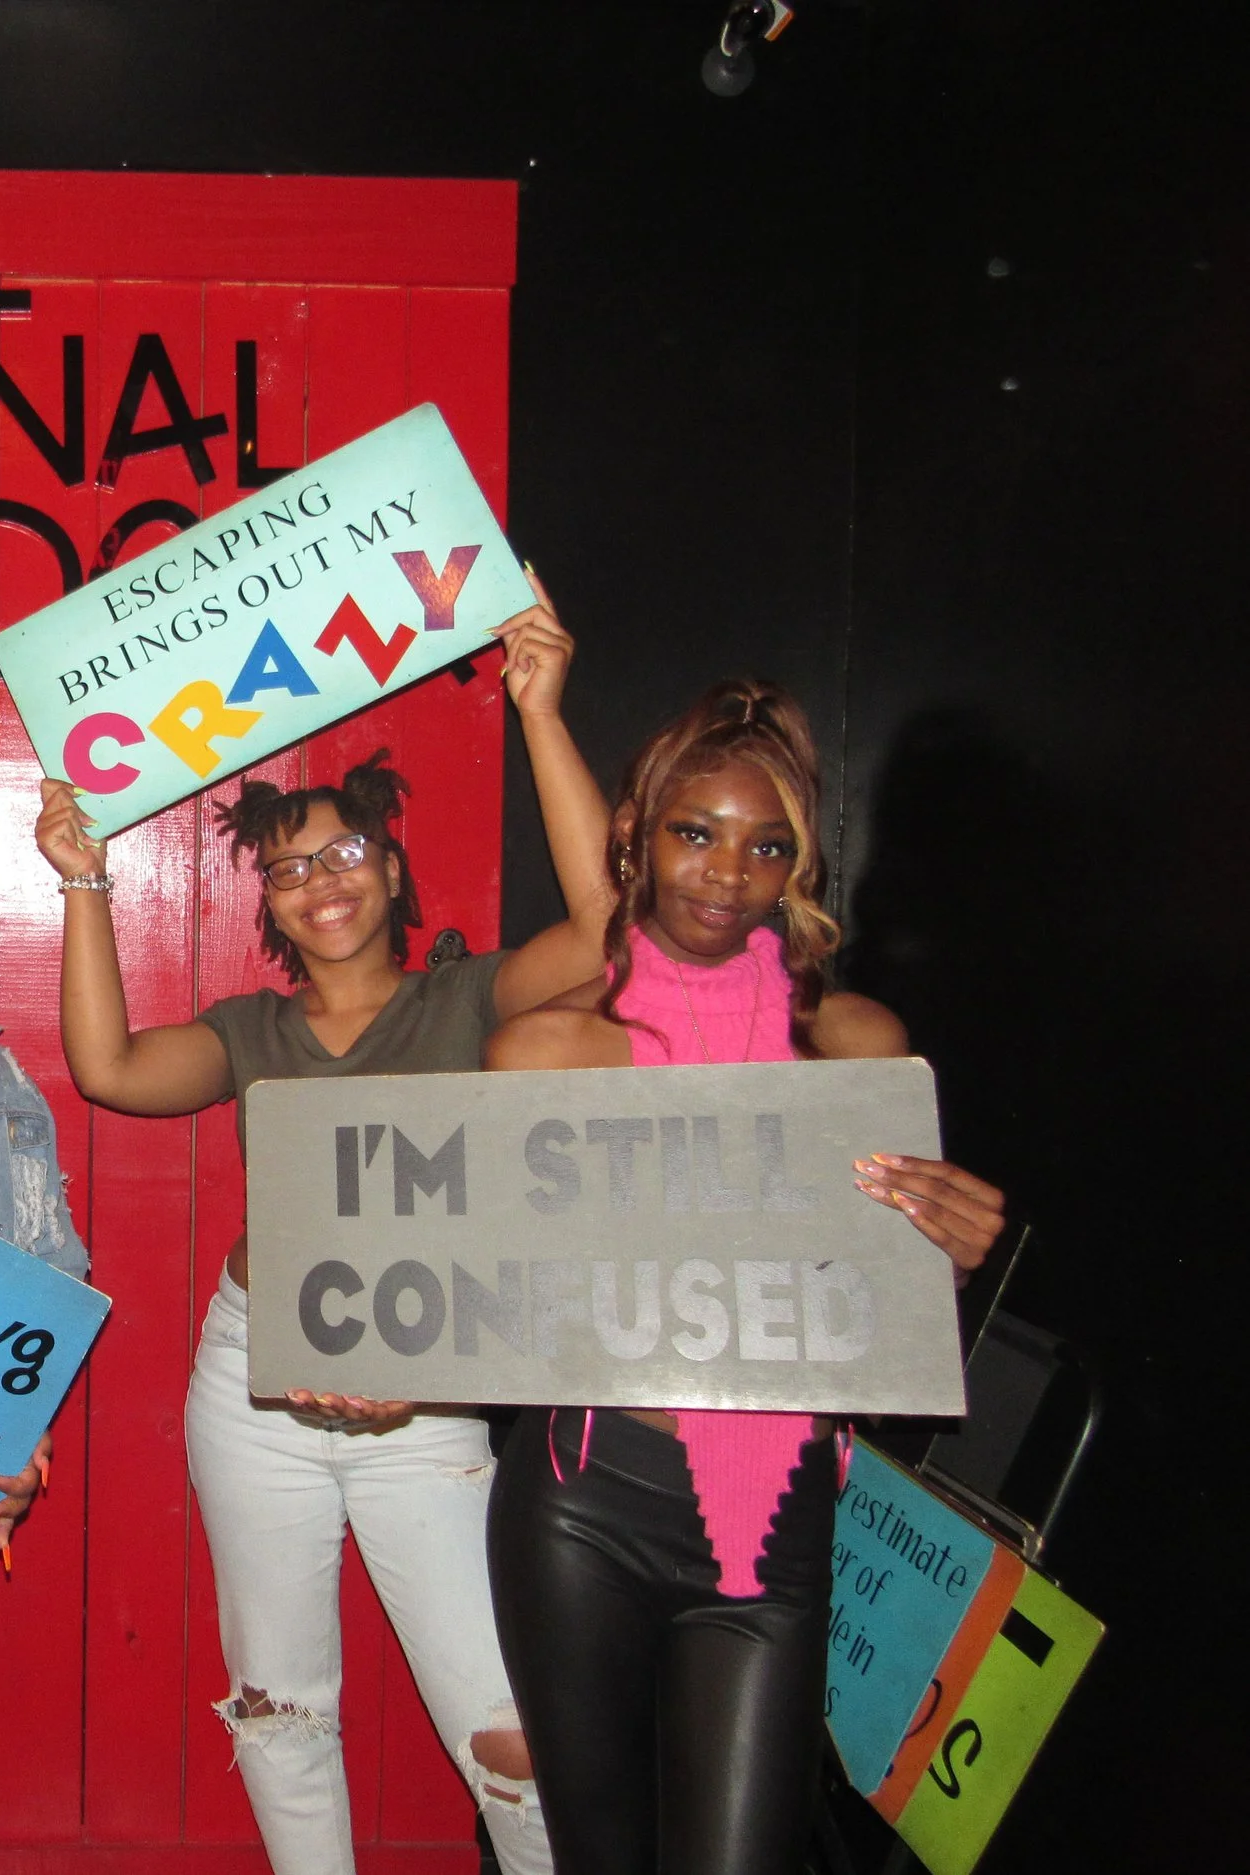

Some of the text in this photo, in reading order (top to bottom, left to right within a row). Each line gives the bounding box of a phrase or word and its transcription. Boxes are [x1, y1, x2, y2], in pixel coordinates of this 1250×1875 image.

[59, 489, 424, 706] BRINGS OUT MY
[101, 481, 333, 627] ESCAPING
[62, 544, 483, 796] CRAZY
[335, 1113, 821, 1218] I'M STILL
[298, 1257, 878, 1363] CONFUSED
[854, 1565, 894, 1606] of
[847, 1625, 876, 1677] in
